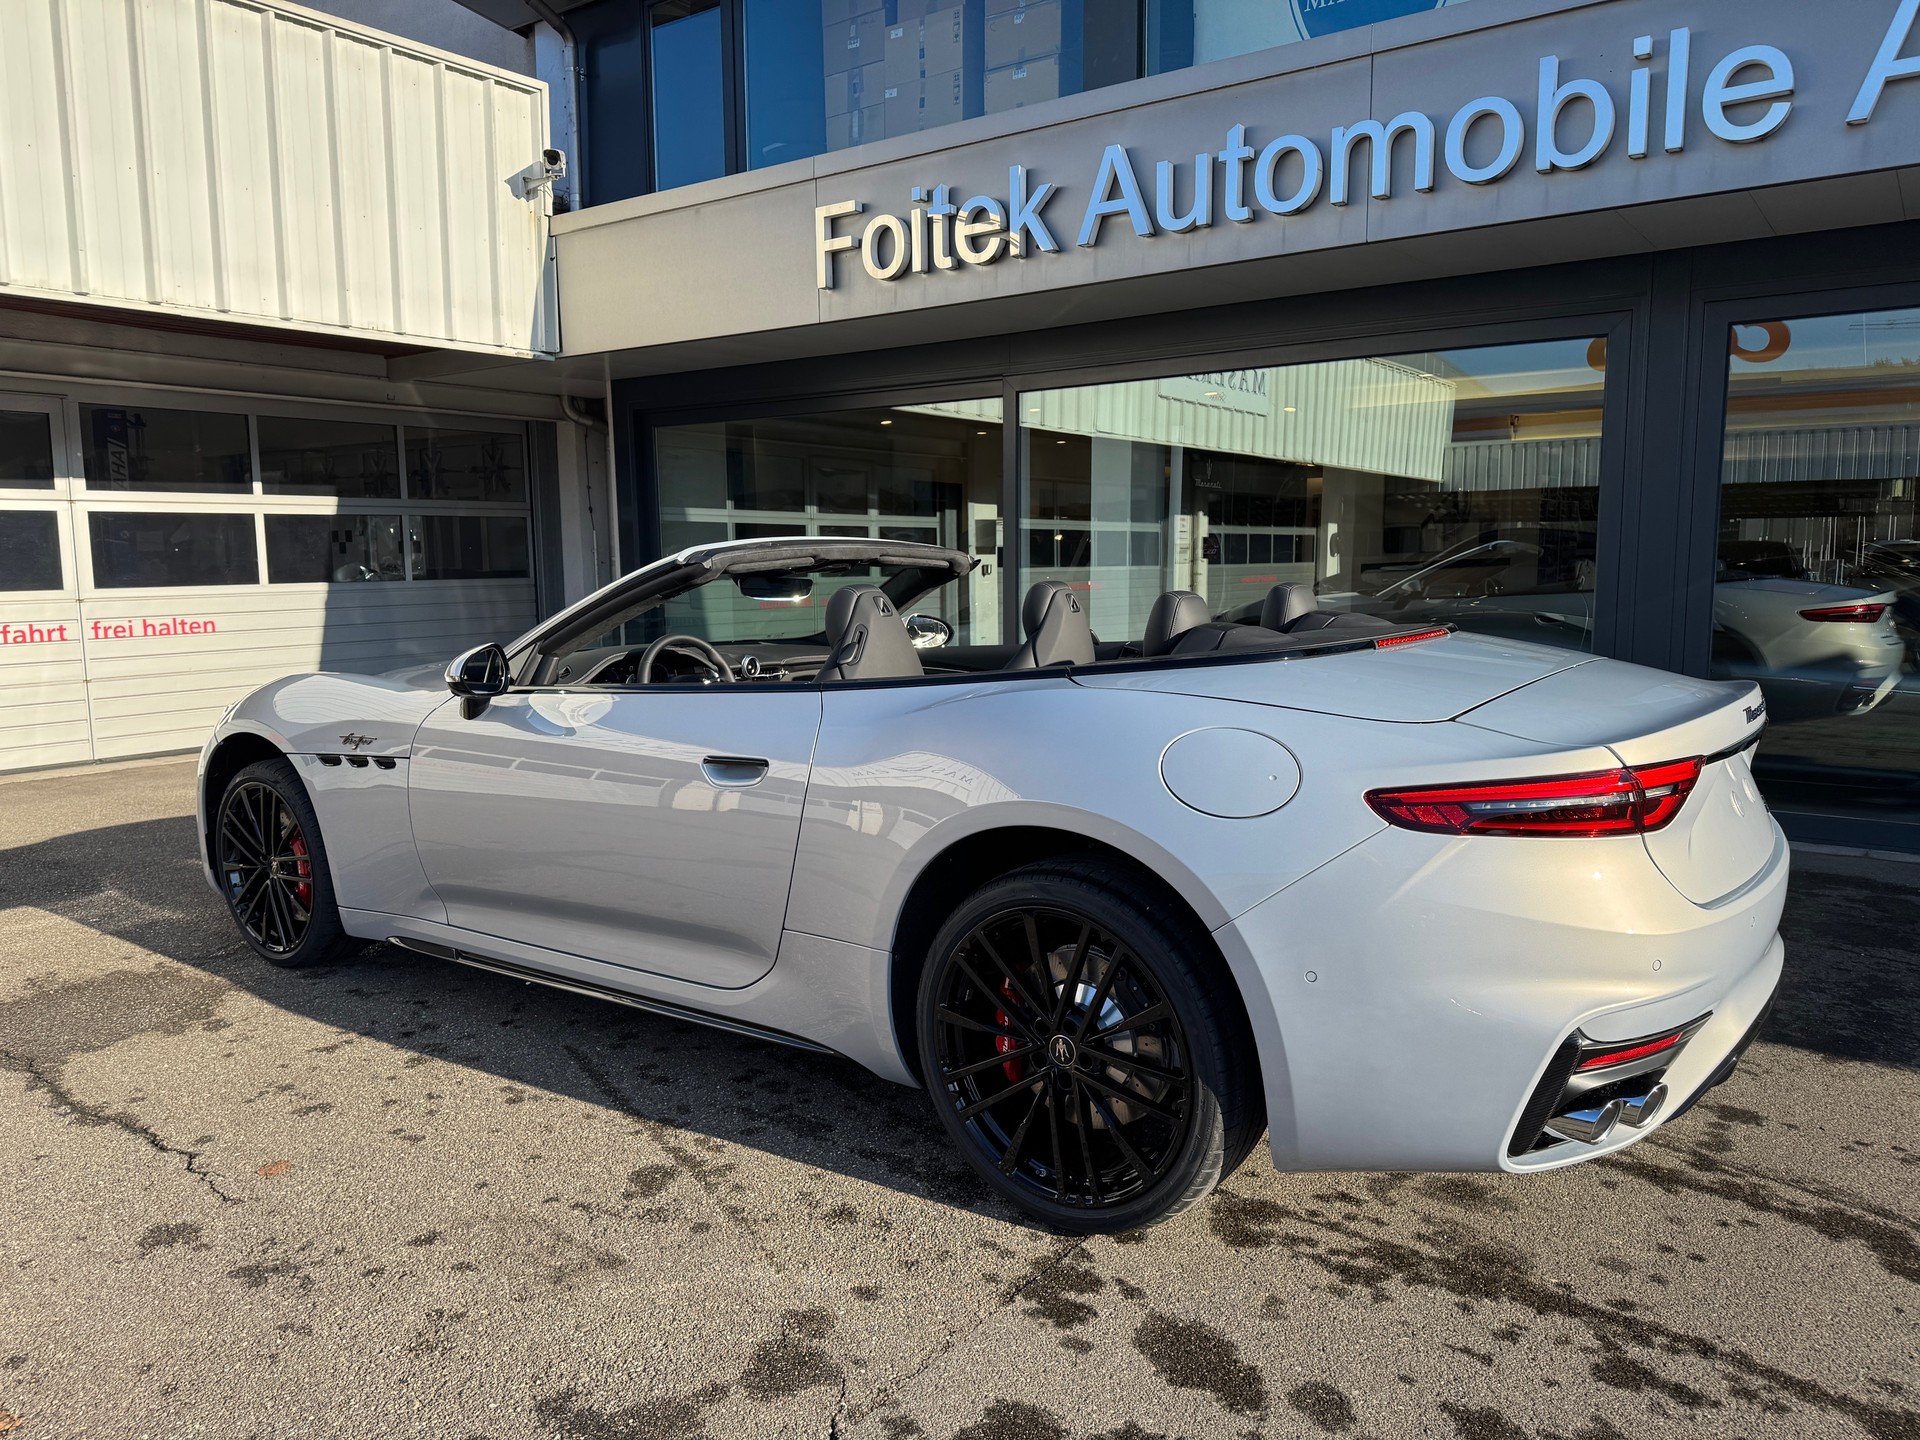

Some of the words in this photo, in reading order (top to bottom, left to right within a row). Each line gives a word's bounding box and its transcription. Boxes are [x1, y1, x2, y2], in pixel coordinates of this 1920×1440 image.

[816, 164, 1061, 290] Foitek
[1076, 26, 1795, 248] Automobile
[0, 624, 68, 645] fahrt
[91, 620, 135, 640] frei
[142, 617, 217, 637] halten
